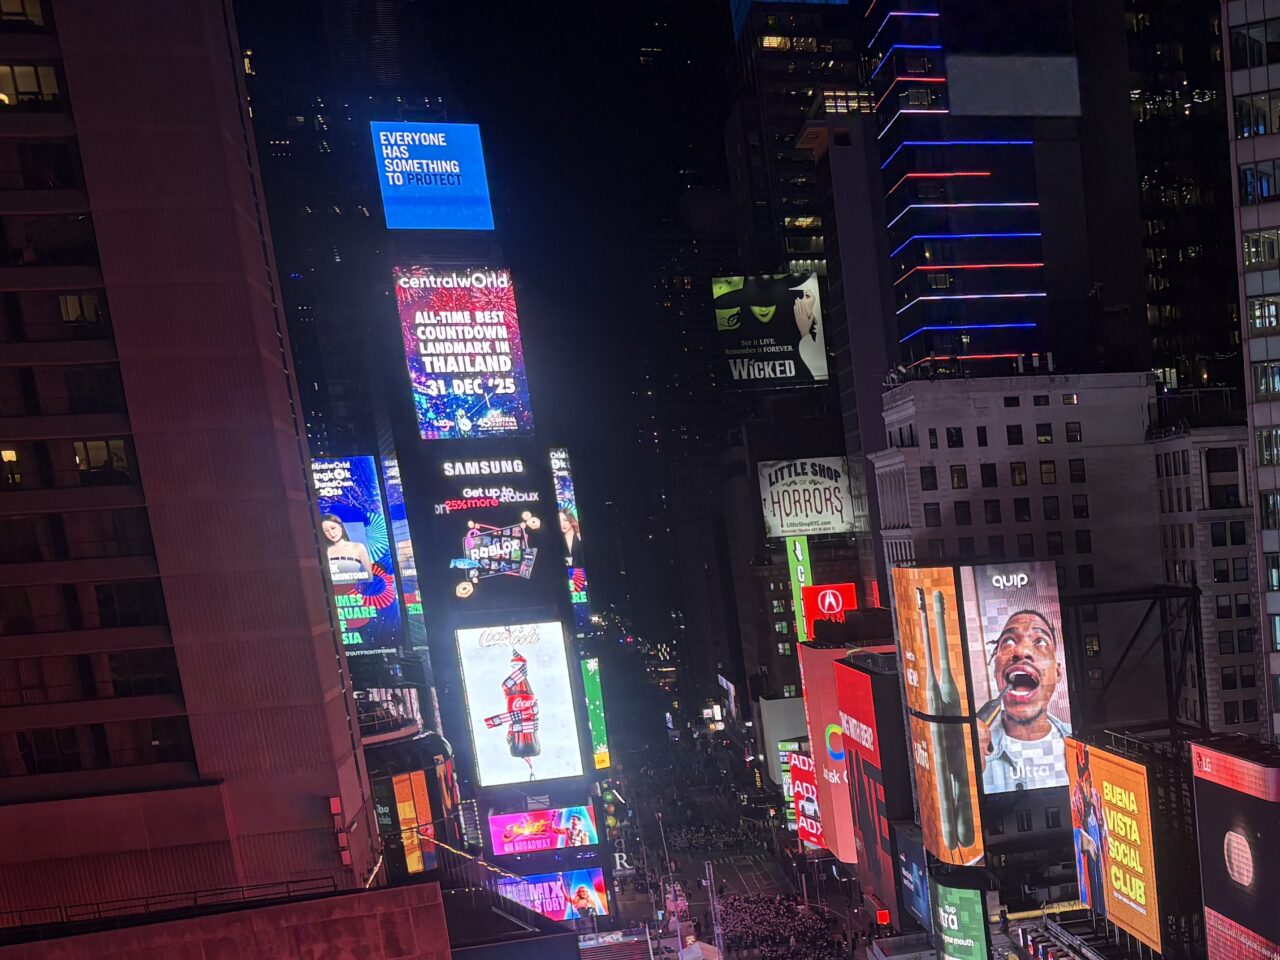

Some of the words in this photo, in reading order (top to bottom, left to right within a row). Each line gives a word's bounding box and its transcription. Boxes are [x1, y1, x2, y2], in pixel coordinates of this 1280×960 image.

[380, 132, 447, 146] EVERYONE
[382, 145, 409, 158] HAS
[385, 159, 460, 173] SOMETHING
[386, 172, 404, 186] TO
[407, 173, 462, 186] PROTECT
[415, 311, 471, 324] ALL-TIME
[475, 311, 505, 324] BEST
[417, 325, 508, 339] COUNTDOWN
[420, 341, 492, 354] LANDMARK
[495, 341, 511, 353] IN
[763, 345, 794, 353] FOREVER.
[422, 355, 512, 373] THAILAND
[426, 379, 446, 395] 31
[453, 379, 484, 395] DEC
[488, 378, 516, 394] '25
[443, 460, 524, 476] SAMSUNG
[768, 462, 808, 487] LITTLE
[811, 463, 841, 484] SHOP
[463, 488, 482, 498] Get
[485, 488, 500, 500] up
[501, 486, 514, 496] to
[500, 491, 539, 502] Robux
[467, 497, 499, 509] more
[771, 486, 844, 526] HORRORS
[470, 539, 521, 561] ROBLOX
[992, 573, 1028, 590] quip
[1009, 763, 1050, 780] ultra
[1103, 780, 1138, 814] BUENA
[1105, 807, 1141, 845] VISTA
[1108, 836, 1144, 874] SOCIAL
[1111, 865, 1146, 906] CLUB
